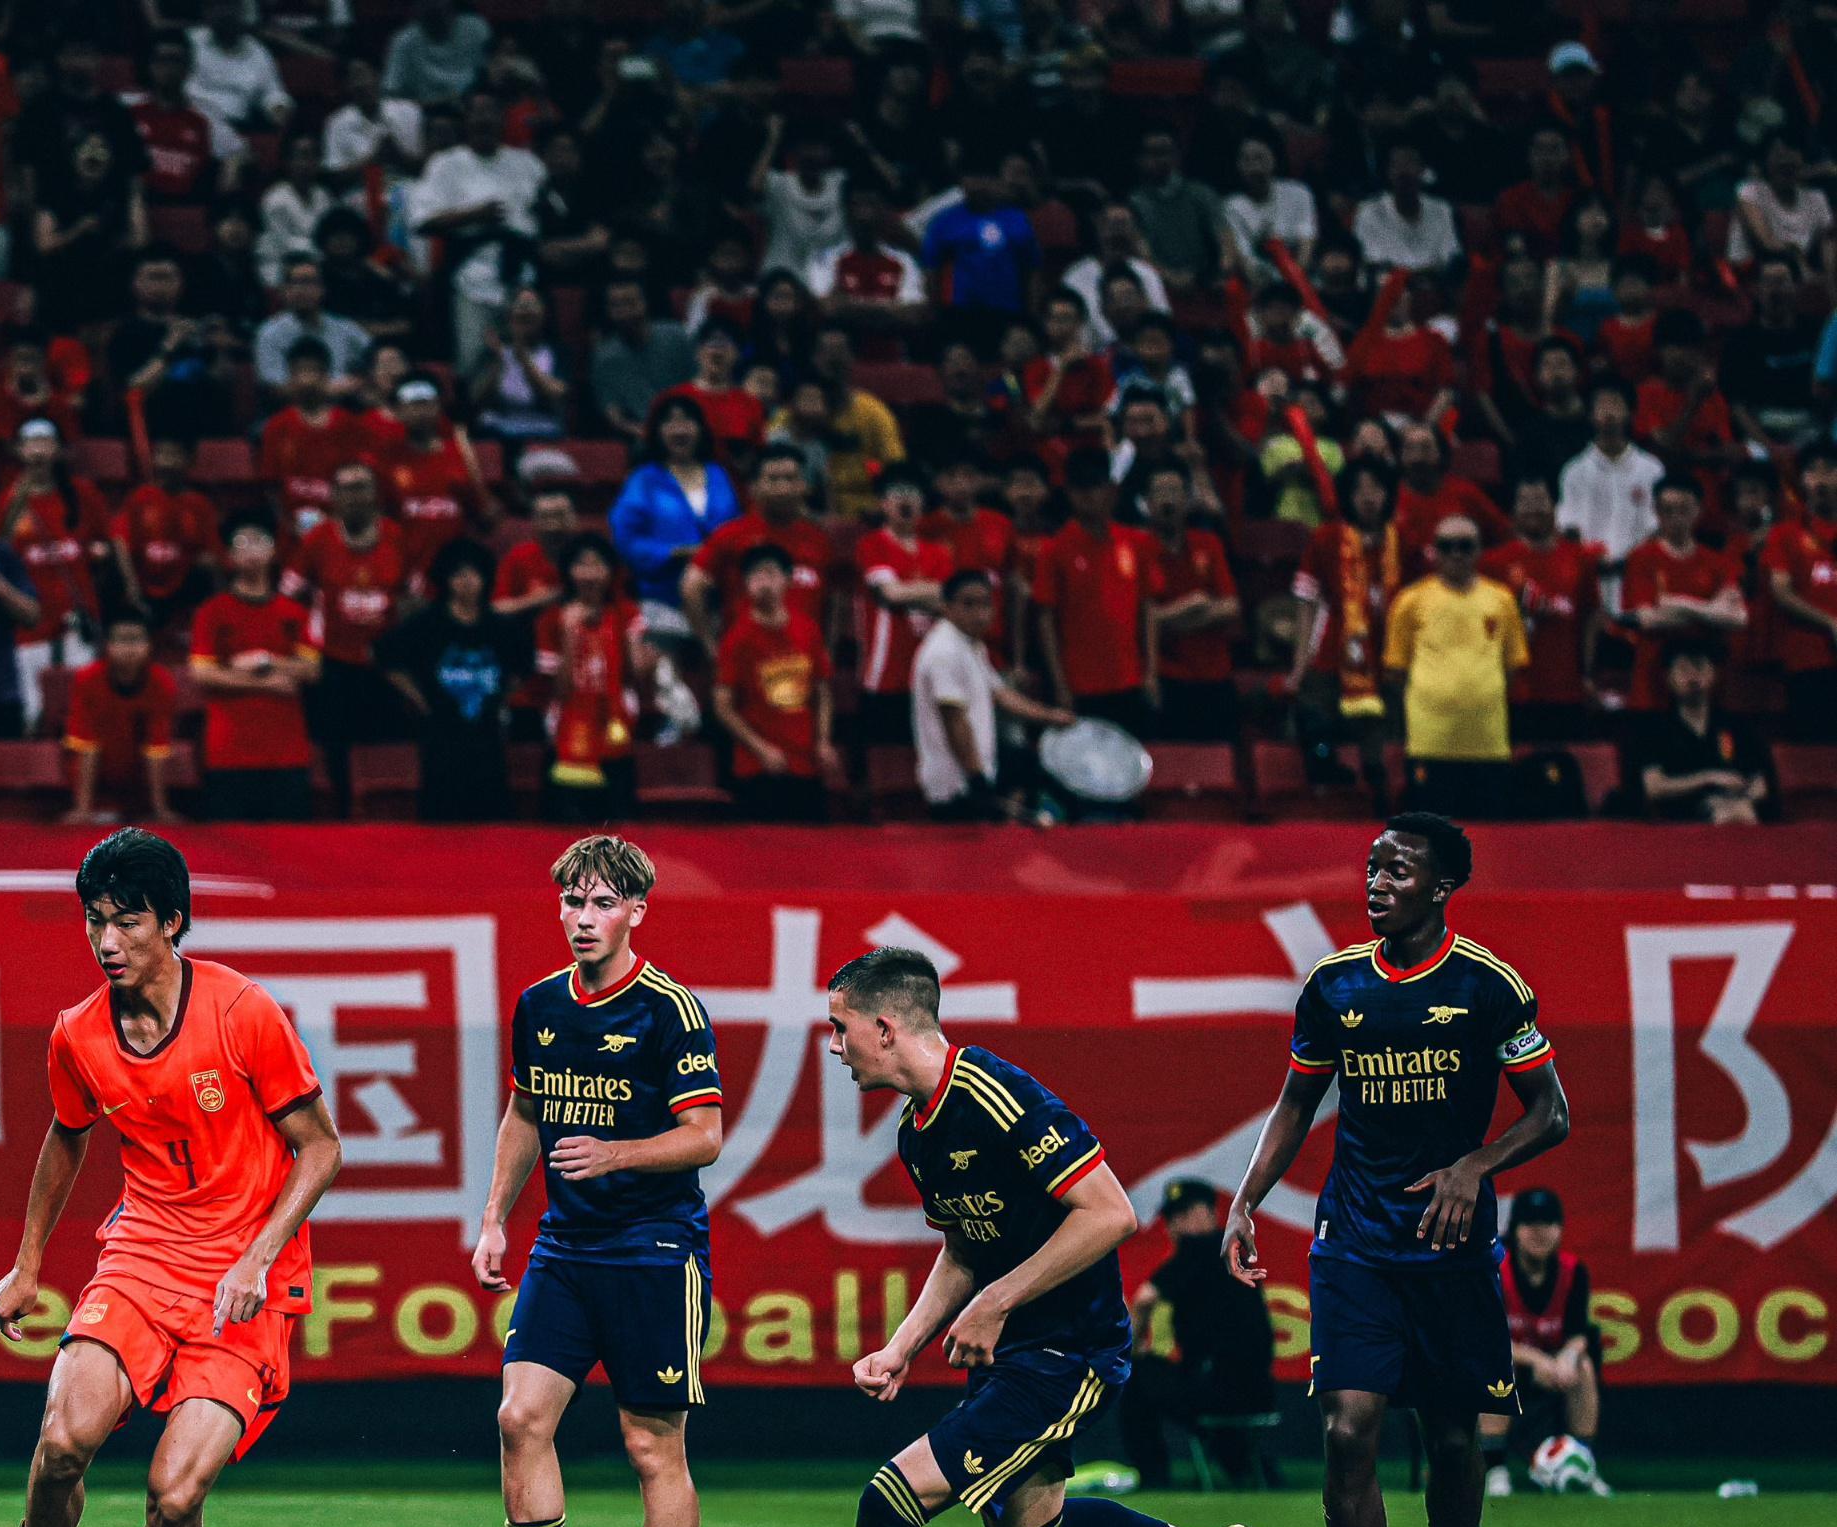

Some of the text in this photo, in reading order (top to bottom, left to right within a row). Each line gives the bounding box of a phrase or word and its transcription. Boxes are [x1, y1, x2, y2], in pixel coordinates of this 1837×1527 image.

[1342, 1046, 1461, 1077] Emirates
[193, 1072, 217, 1084] CFA
[529, 1066, 632, 1101] Emirates
[1362, 1077, 1446, 1104] FLY BETTER
[543, 1100, 614, 1127] FLY BETTER
[164, 1139, 199, 1190] 4
[300, 1264, 908, 1362] Foall
